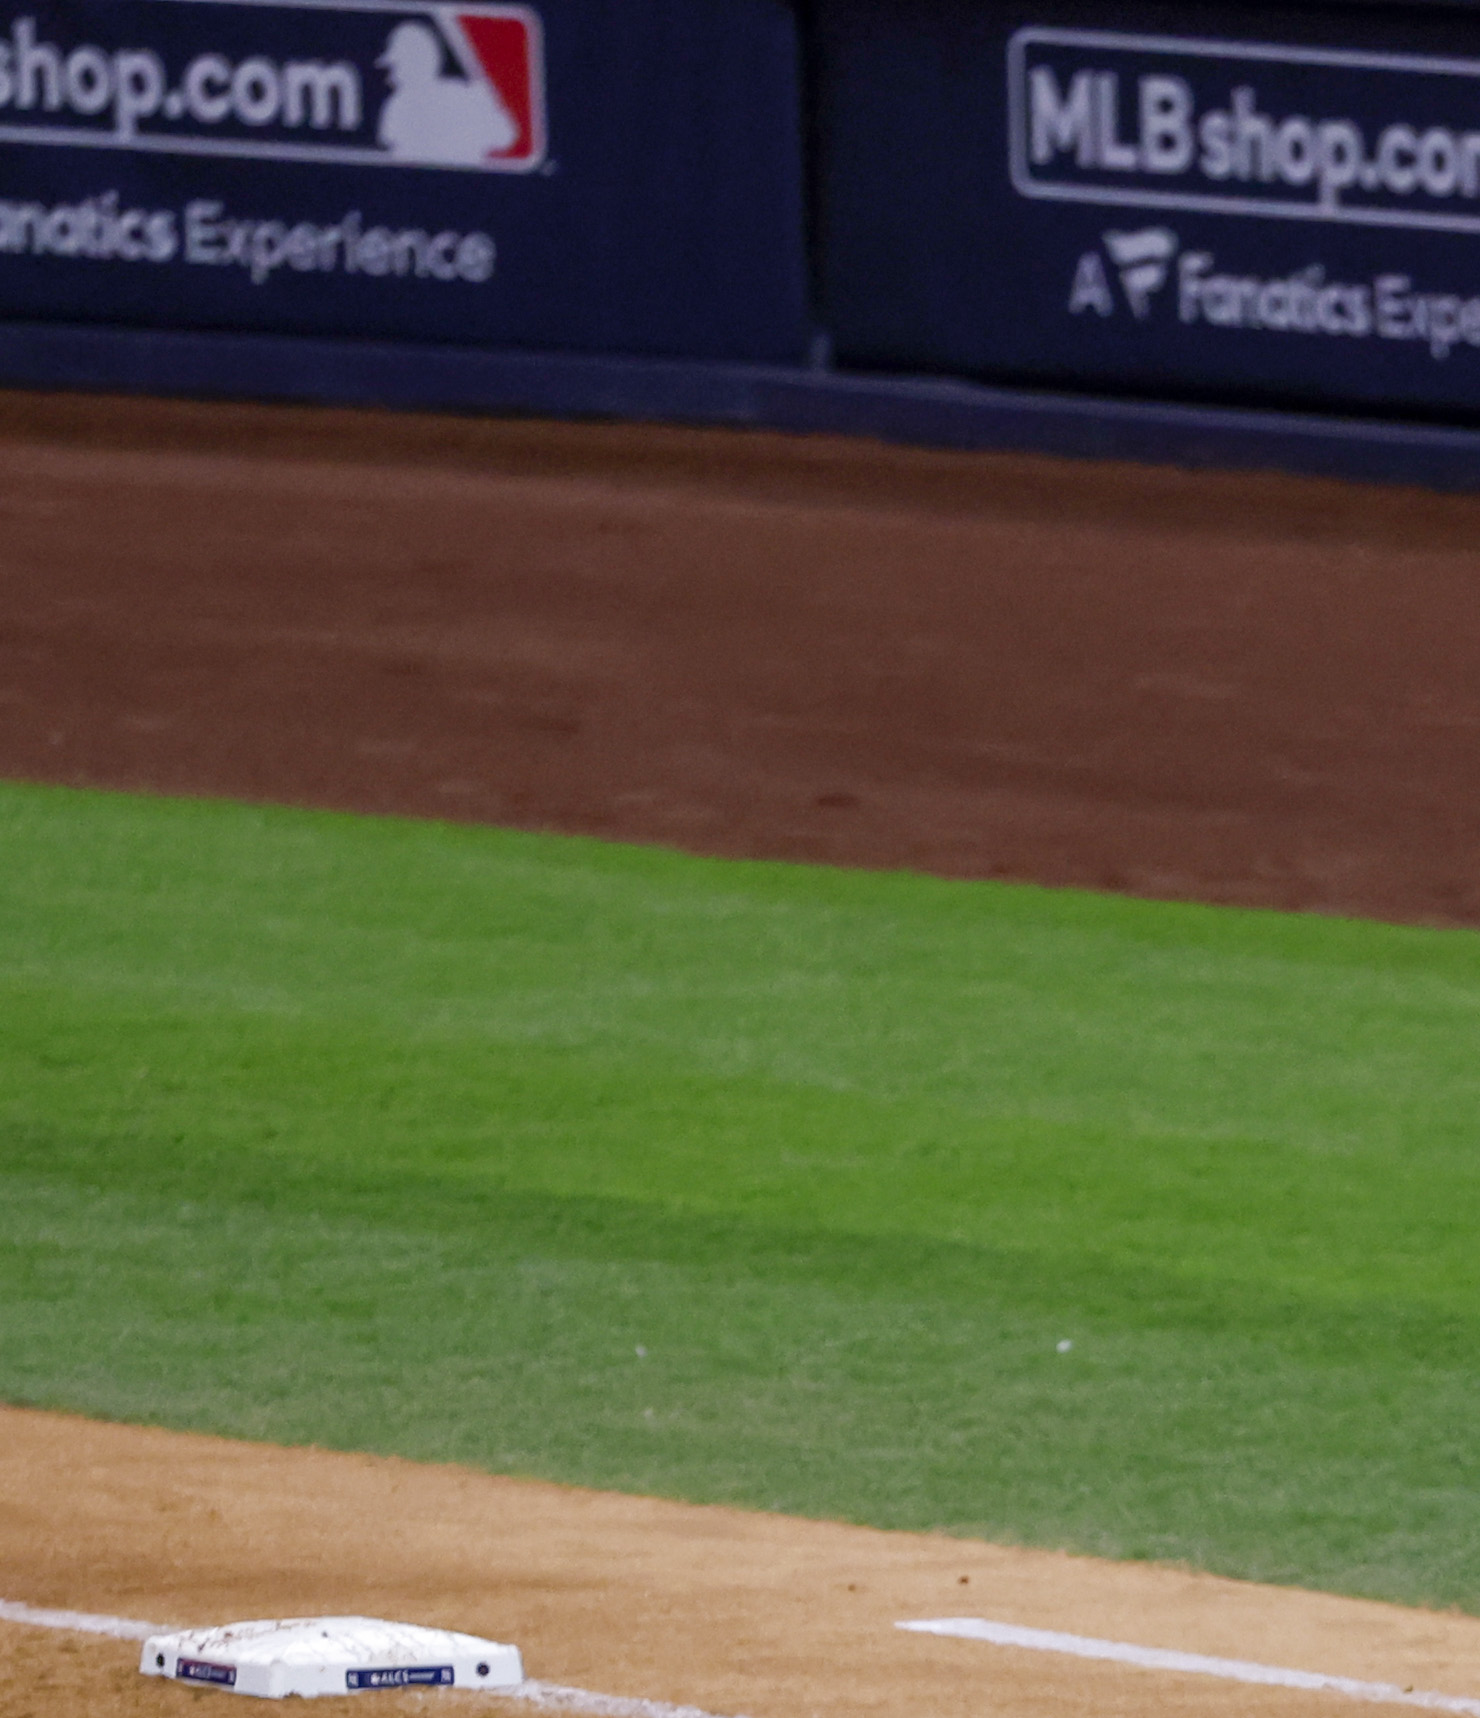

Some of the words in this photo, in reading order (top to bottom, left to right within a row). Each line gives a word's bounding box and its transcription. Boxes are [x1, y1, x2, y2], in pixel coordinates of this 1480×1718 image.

[183, 199, 497, 285] Experience
[1068, 251, 1114, 317] A
[1178, 250, 1373, 337] Fanatics
